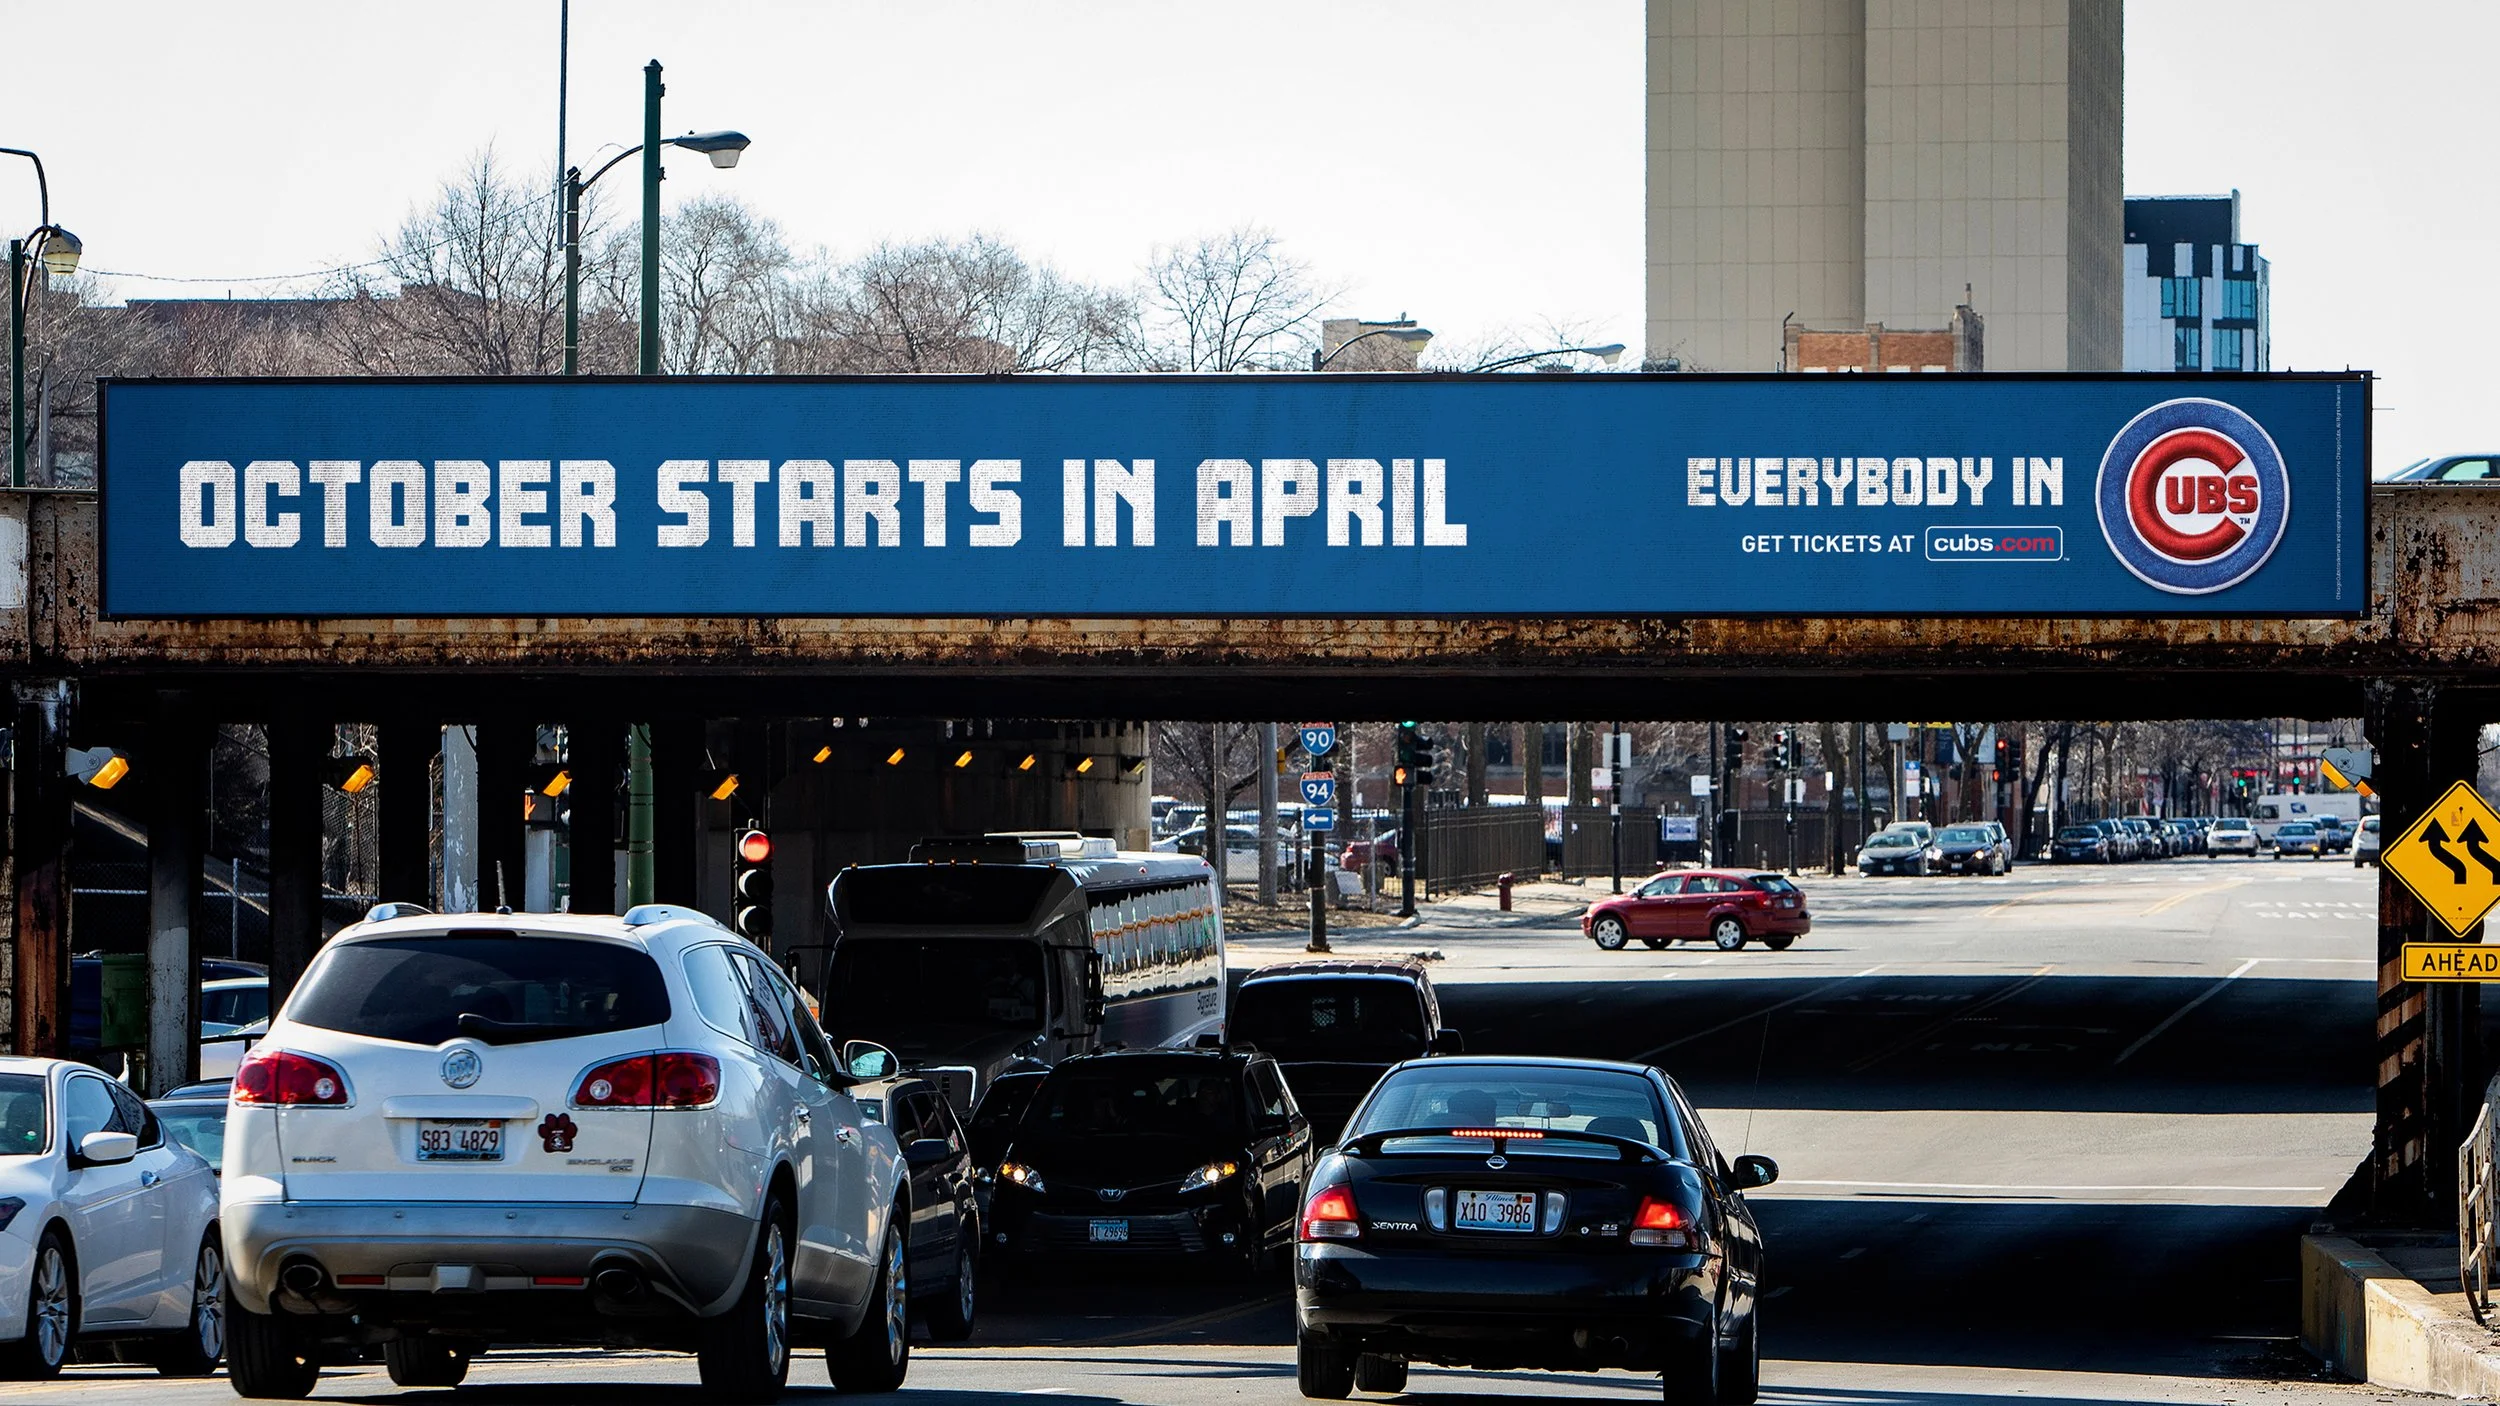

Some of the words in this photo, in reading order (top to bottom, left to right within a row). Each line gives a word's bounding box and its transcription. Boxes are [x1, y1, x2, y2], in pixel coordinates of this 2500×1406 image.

[1687, 457, 1993, 506] EVERYBODY
[2012, 457, 2063, 506] IN
[180, 460, 616, 548] OCTOBER
[657, 459, 1021, 547] STARTS
[1063, 459, 1155, 547] IN
[1196, 459, 1467, 547] APRIL
[2129, 430, 2259, 560] CUBS
[1741, 535, 1784, 553] GET
[1790, 535, 1882, 553] TICKETS
[1888, 535, 1915, 553] AT
[1934, 534, 2055, 552] cubs.com
[1306, 731, 1330, 747] 90
[1306, 782, 1329, 799] 94
[2421, 953, 2498, 972] AHEAD
[421, 1129, 451, 1152] S83
[460, 1129, 499, 1152] 4829
[1461, 1202, 1487, 1222] X10
[1497, 1203, 1531, 1224] 3986
[1371, 1221, 1418, 1231] SENTRA
